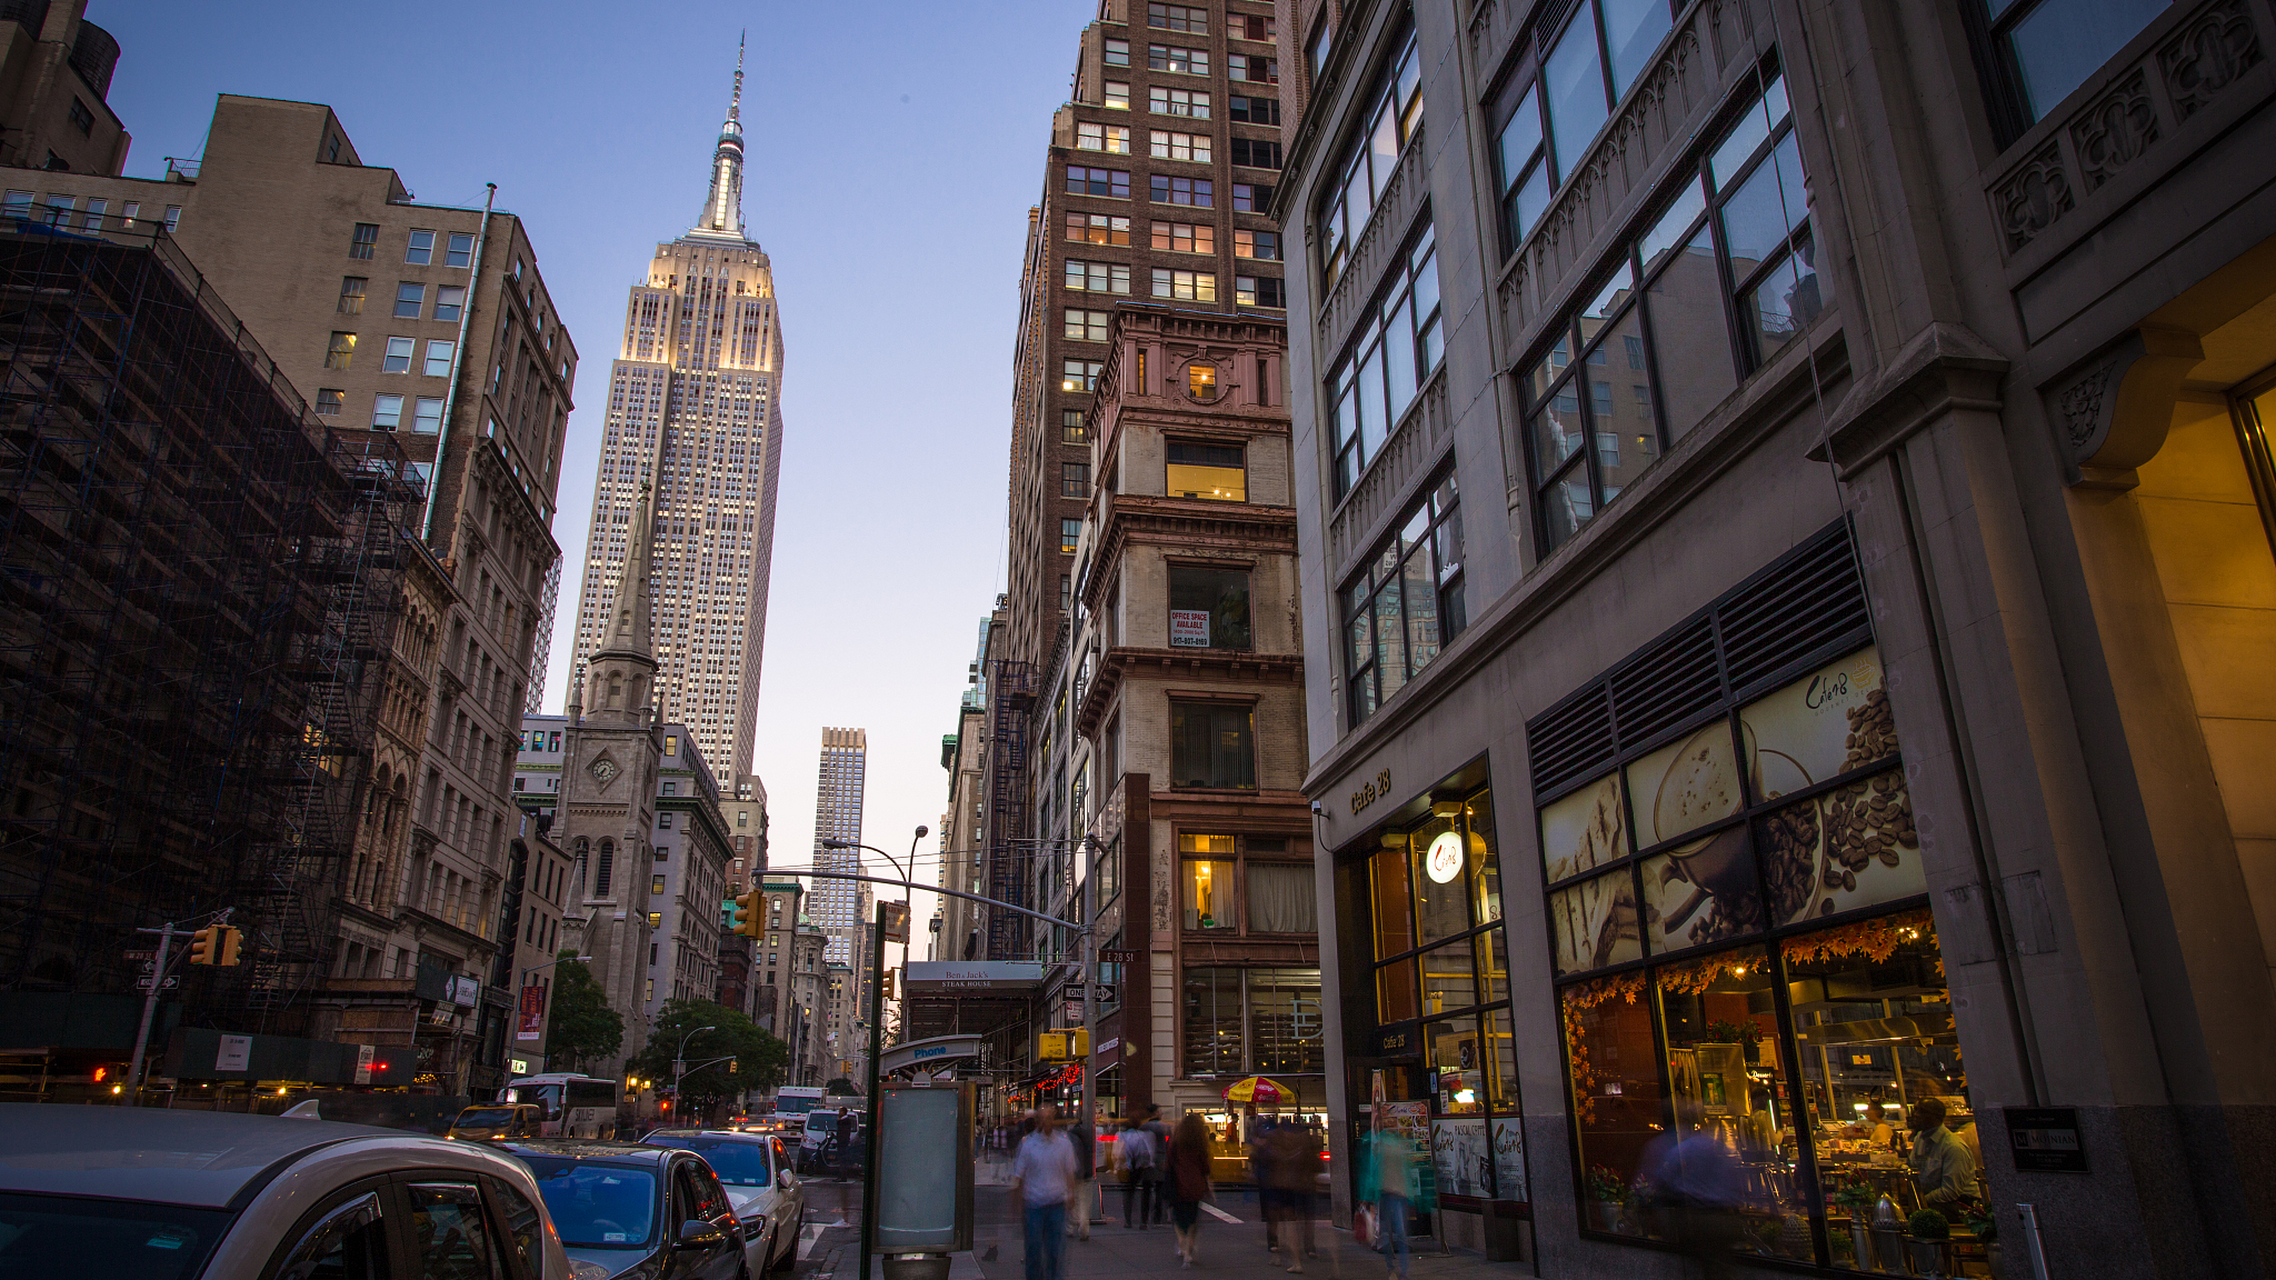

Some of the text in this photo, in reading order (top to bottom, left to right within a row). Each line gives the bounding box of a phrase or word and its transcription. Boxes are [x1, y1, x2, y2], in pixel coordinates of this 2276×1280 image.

[1172, 612, 1207, 621] OFFICE SPACE
[1177, 621, 1203, 629] AVAILABLE
[1351, 768, 1391, 815] Cafe 28
[1107, 953, 1134, 961] E 28 St
[946, 971, 960, 979] Ben
[966, 971, 989, 979] Jack's
[914, 1046, 947, 1058] Phone
[2032, 1135, 2076, 1144] MOINIAN
